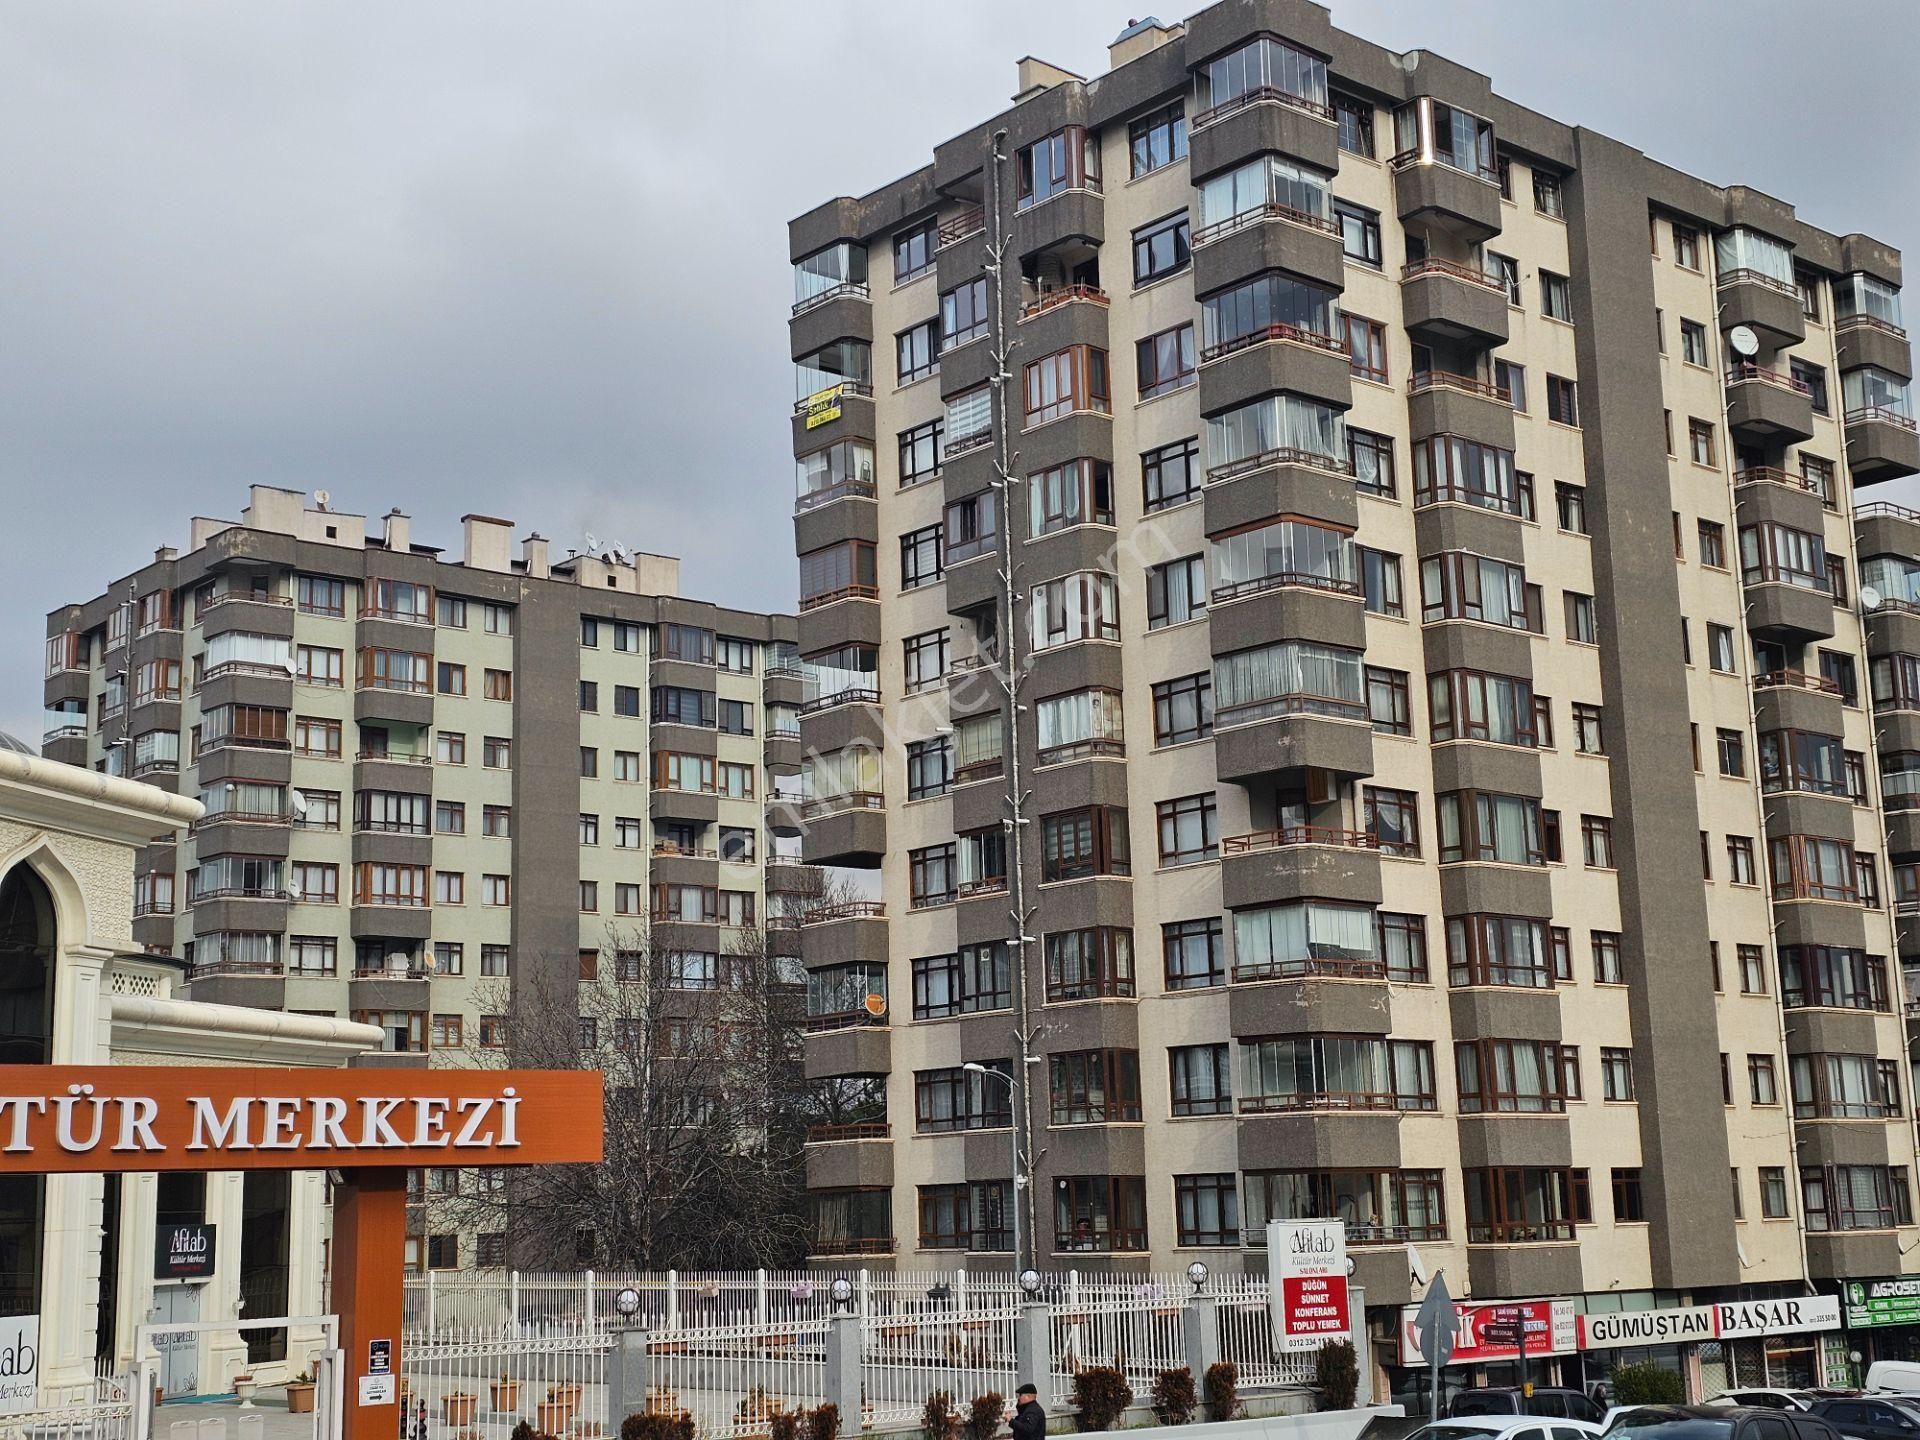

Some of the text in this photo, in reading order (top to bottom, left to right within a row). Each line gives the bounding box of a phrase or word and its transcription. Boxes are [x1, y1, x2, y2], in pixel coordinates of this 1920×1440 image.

[0, 1084, 522, 1151] TÜR MERKEZİ
[1302, 1280, 1327, 1291] DÜĞÜN
[1301, 1293, 1330, 1304] SÜNNET
[1294, 1306, 1338, 1318] KONFERANS
[1721, 1301, 1804, 1334] BAŞAR
[1292, 1319, 1341, 1331] TOPLU YEMEK
[1593, 1313, 1709, 1341] GÜMÜŞTAN
[1288, 1338, 1304, 1347] 0312
[1305, 1338, 1317, 1346] 334
